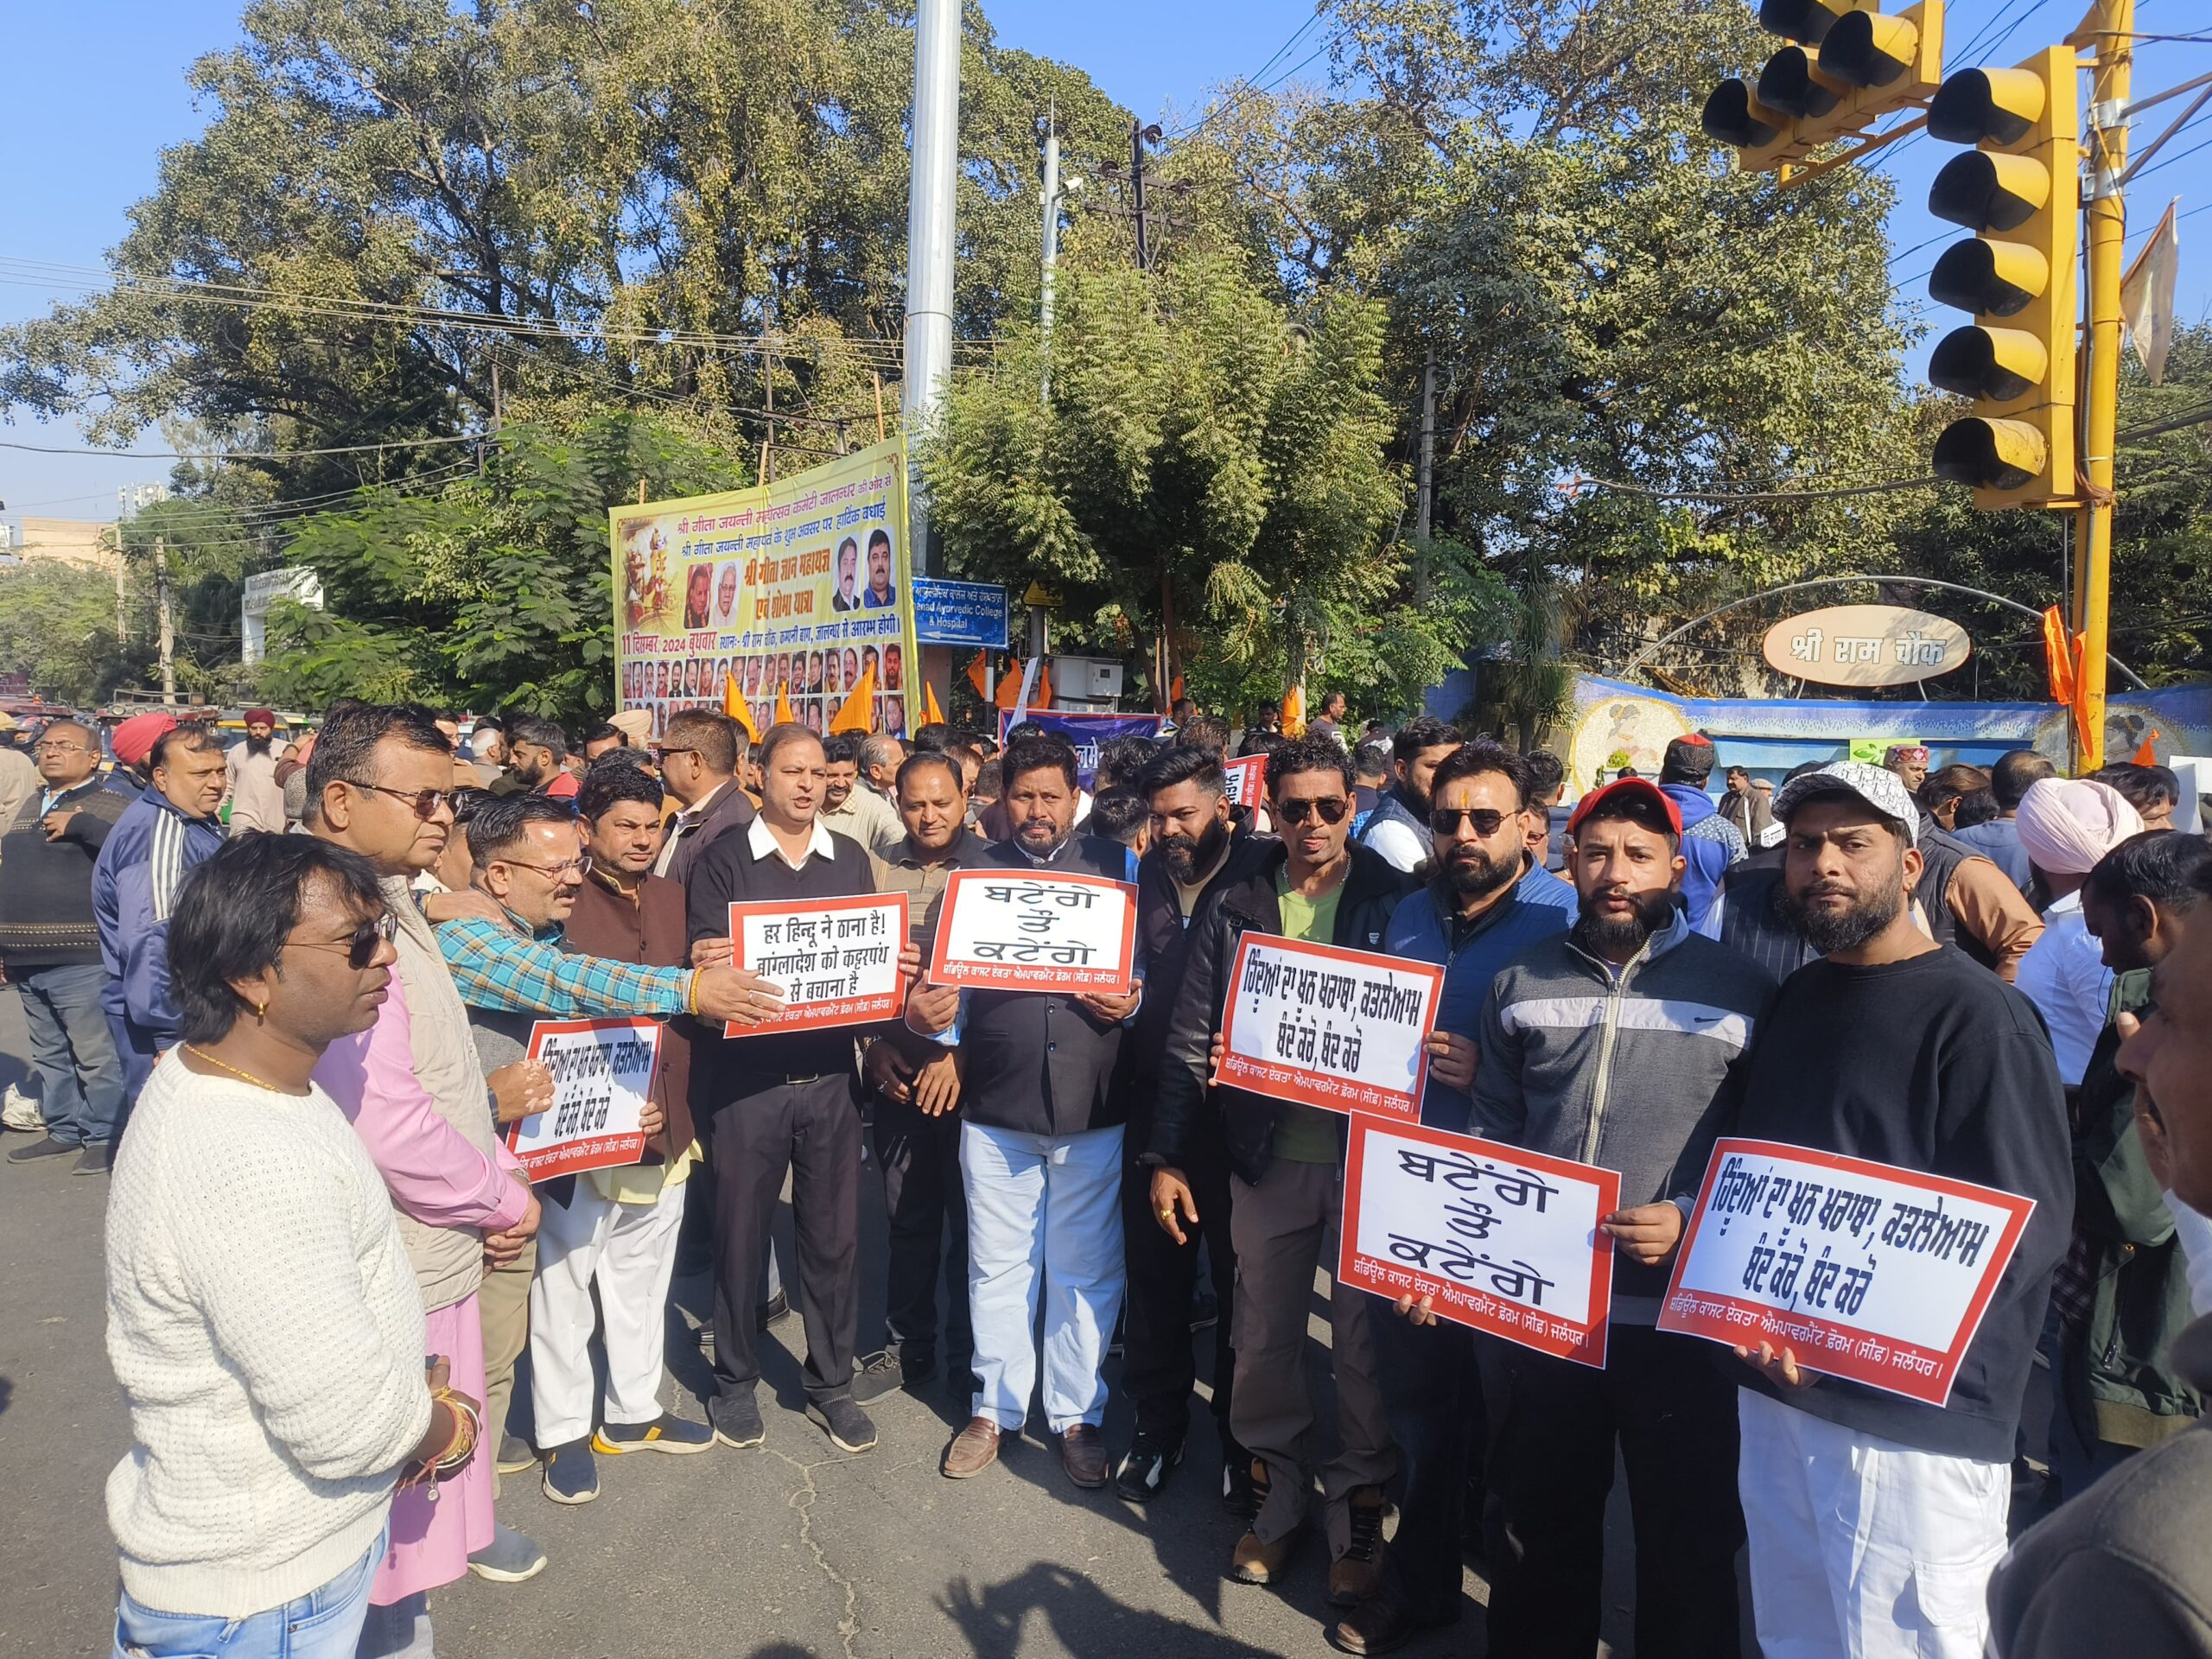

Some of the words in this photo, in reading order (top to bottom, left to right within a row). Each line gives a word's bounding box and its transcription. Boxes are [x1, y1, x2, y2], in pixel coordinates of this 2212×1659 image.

[677, 518, 689, 534] श्री
[692, 515, 715, 532] गीता
[719, 507, 753, 530] जयन्ती
[756, 504, 791, 524] महोत्सव
[793, 490, 817, 514] कमेटी
[820, 483, 855, 505] जालन्धर
[868, 476, 883, 490] ओर
[884, 472, 892, 486] से
[682, 540, 691, 557] श्री
[694, 539, 713, 556] गीता
[716, 533, 743, 554] जयन्ती
[774, 527, 783, 543] के
[798, 520, 820, 537] अवसर
[823, 517, 833, 530] पर
[862, 495, 886, 522] बधाई
[744, 557, 757, 586] श्री
[759, 556, 779, 584] गीता
[780, 556, 798, 582] ज्ञान
[756, 590, 771, 620] एवं
[793, 589, 813, 615] यात्रा
[913, 601, 935, 612] anad
[936, 601, 974, 615] Ayurvedic
[975, 605, 1002, 620] College
[929, 615, 935, 626] &
[937, 615, 967, 629] Hospital
[622, 634, 631, 655] 11
[663, 638, 686, 652] 2024
[689, 631, 717, 657] बुधवार
[741, 631, 750, 648] श्री
[752, 633, 763, 647] राम
[842, 618, 849, 637] से
[850, 620, 876, 636] आरम्भ
[1791, 627, 1824, 663] श्री
[1834, 636, 1885, 664] राम
[984, 881, 1101, 908] ਬਟੇਂਗੇ
[764, 924, 782, 944] हर
[786, 917, 817, 948] हिन्दू
[821, 914, 833, 939] ने
[837, 918, 867, 938] ठाना
[870, 910, 885, 935] है!
[757, 949, 817, 977] बांग्लादेश
[821, 945, 839, 970] को
[843, 942, 889, 970] कट्टरपंथ
[973, 938, 1096, 965] ਕਟੇਂਗੇ
[992, 964, 1013, 979] ਏਕਤਾ
[790, 977, 803, 1002] से
[807, 978, 846, 1000] बचाना
[849, 970, 859, 995] है
[1243, 948, 1282, 1014] ਹਿੰਦੂਆਂ
[1281, 966, 1296, 1000] ਦਾ
[1296, 969, 1318, 1022] ਖੂਨ
[1361, 971, 1422, 1027] ਕਤਲੇਆਮ
[1277, 1011, 1295, 1058] ਬੰਦ
[1297, 1014, 1318, 1071] ਕਰੋ,
[1321, 1020, 1340, 1069] ਬੰਦ
[1342, 1024, 1362, 1073] ਕਰੋ
[1249, 1065, 1268, 1078] ਕਾਸਟ
[1268, 1065, 1292, 1084] ਏਕਤਾ
[554, 1092, 570, 1138] ਬੰਦ
[581, 1087, 597, 1132] ਬੰਦ
[594, 1084, 612, 1130] ਕਰੋ
[1398, 1149, 1560, 1214] ਬਟੇਂਗੇ
[1711, 1157, 1773, 1236] ਹਿੰਦੂਆਂ
[1763, 1177, 1792, 1218] ਦਾ
[1777, 1181, 1823, 1247] ਖੂਨ
[1881, 1195, 1990, 1268] ਕਤਲੇਆਮ
[1388, 1233, 1555, 1306] ਕਟੇਂਗੇ
[1742, 1231, 1776, 1294] ਬੰਦ
[1770, 1237, 1808, 1312] ਕਰੋ,
[1803, 1245, 1841, 1308] ਬੰਦ
[1834, 1254, 1877, 1316] ਕਰੋ
[1388, 1269, 1413, 1289] ਕਾਸਟ
[1414, 1273, 1441, 1296] ਏਕਤਾ
[1442, 1281, 1497, 1317] ਐਮਪਾਵਰਮੈਂਟ
[1700, 1301, 1726, 1319] ਕਾਸਟ
[1726, 1301, 1759, 1326] ਏਕਤਾ
[1761, 1311, 1826, 1346] ਐਮਪਾਵਰਮੈਂਟ
